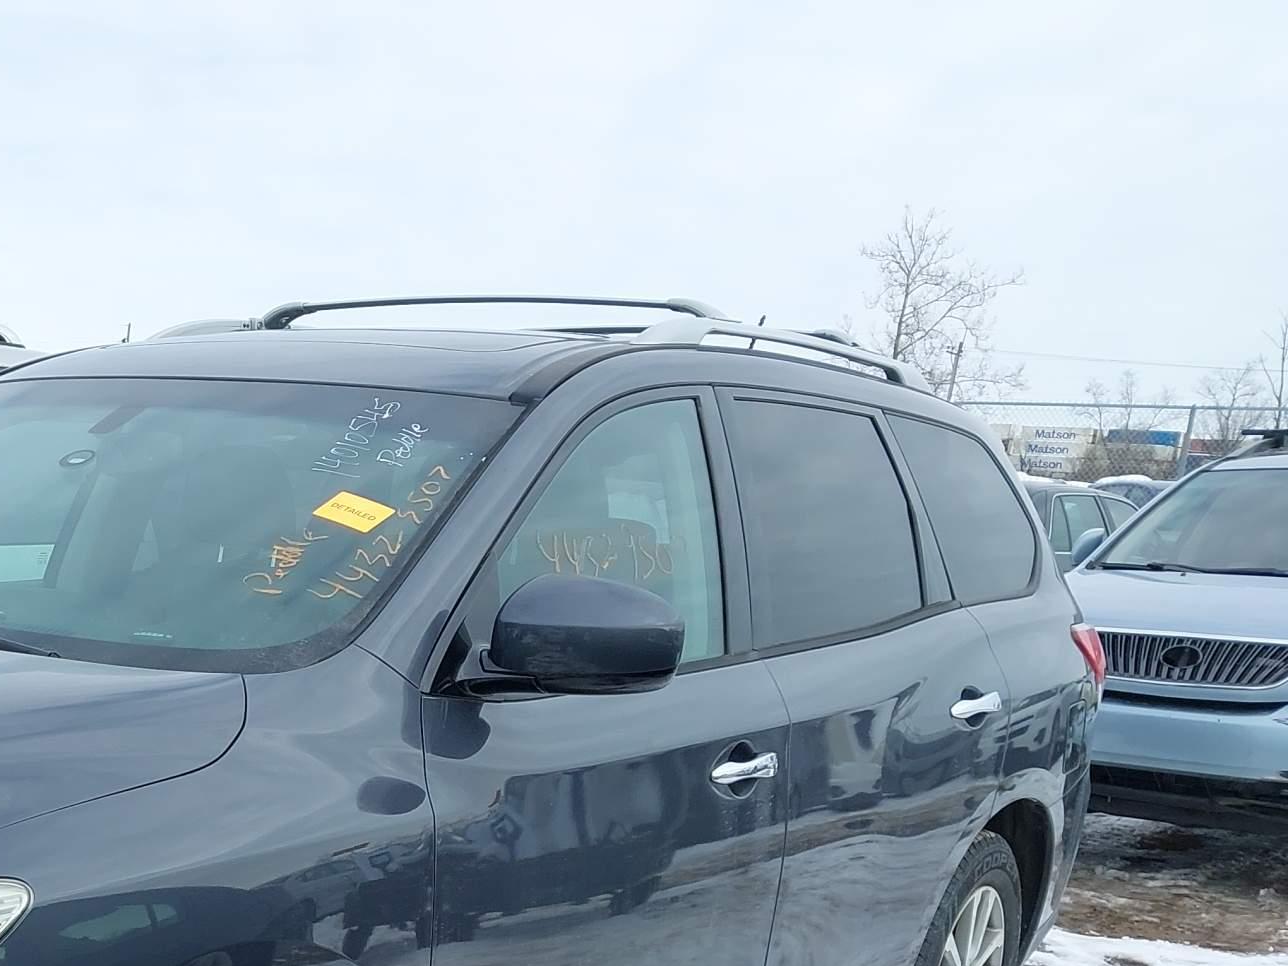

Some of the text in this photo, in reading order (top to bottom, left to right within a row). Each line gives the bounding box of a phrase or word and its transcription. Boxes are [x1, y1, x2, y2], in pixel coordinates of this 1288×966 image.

[1034, 429, 1076, 440] Matson
[1027, 443, 1069, 454] Matson
[1021, 458, 1062, 469] Matson
[331, 502, 377, 521] DETAILED
